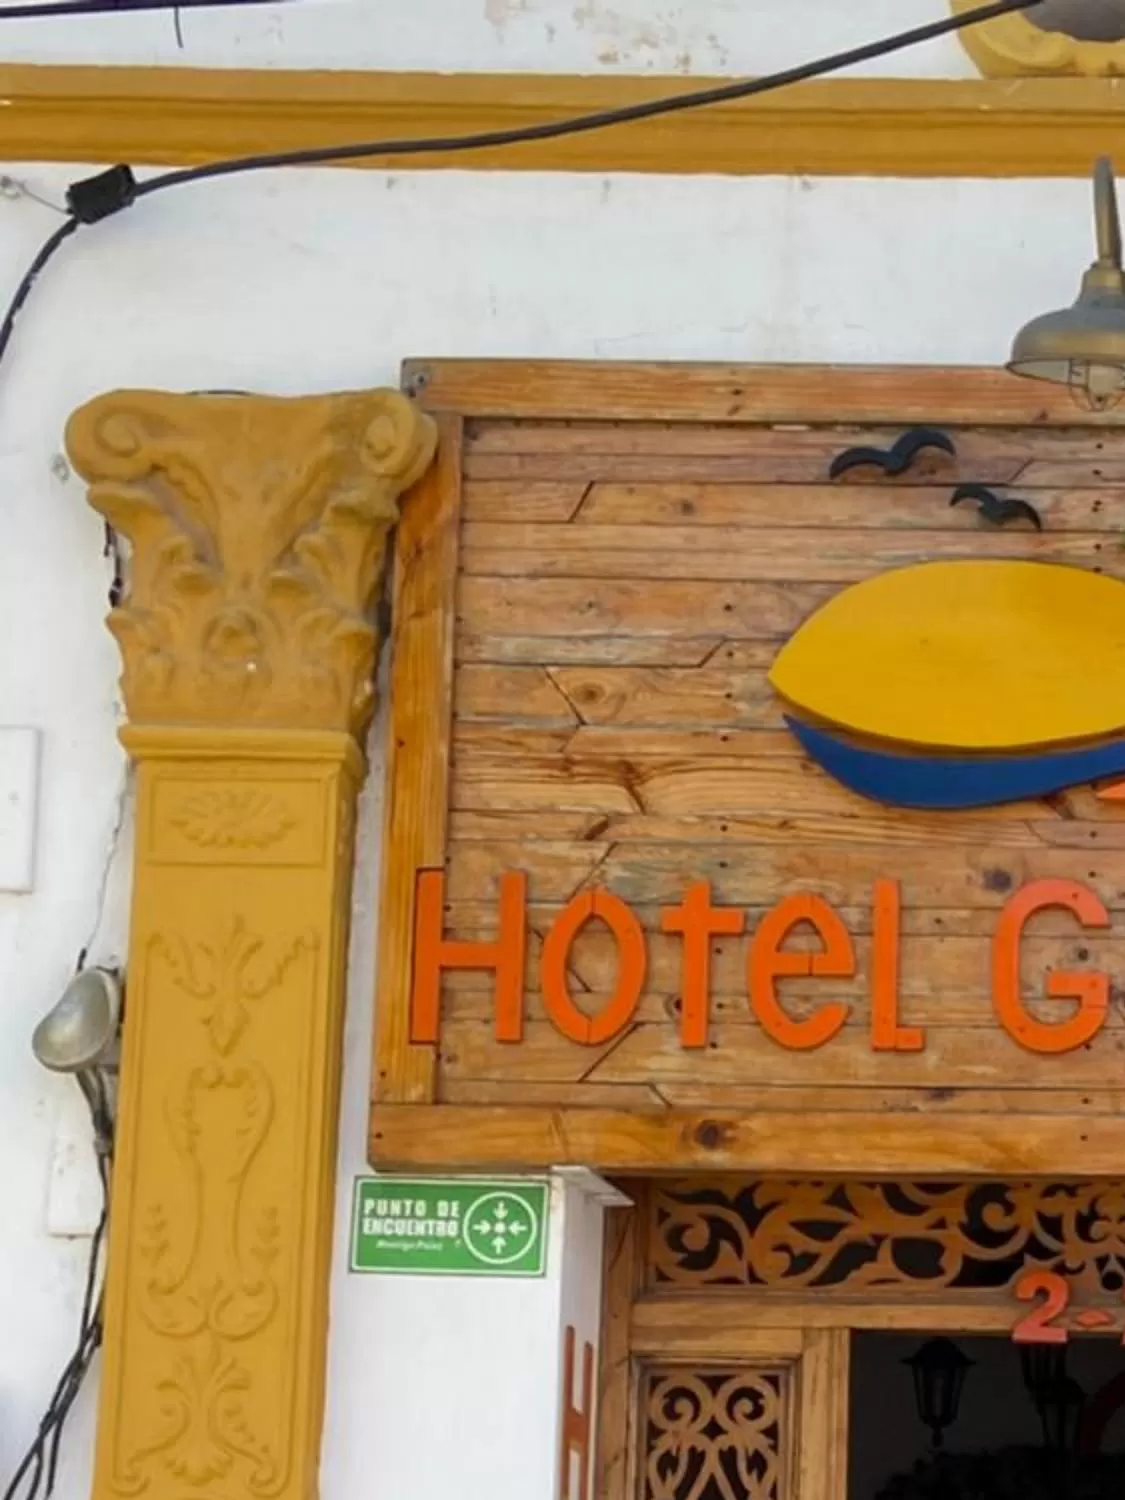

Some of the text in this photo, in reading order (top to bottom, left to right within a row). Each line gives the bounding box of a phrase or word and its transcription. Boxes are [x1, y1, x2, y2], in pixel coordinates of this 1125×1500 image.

[363, 1198, 460, 1217] PUNTO DE
[362, 1217, 459, 1236] ENCUENTRO
